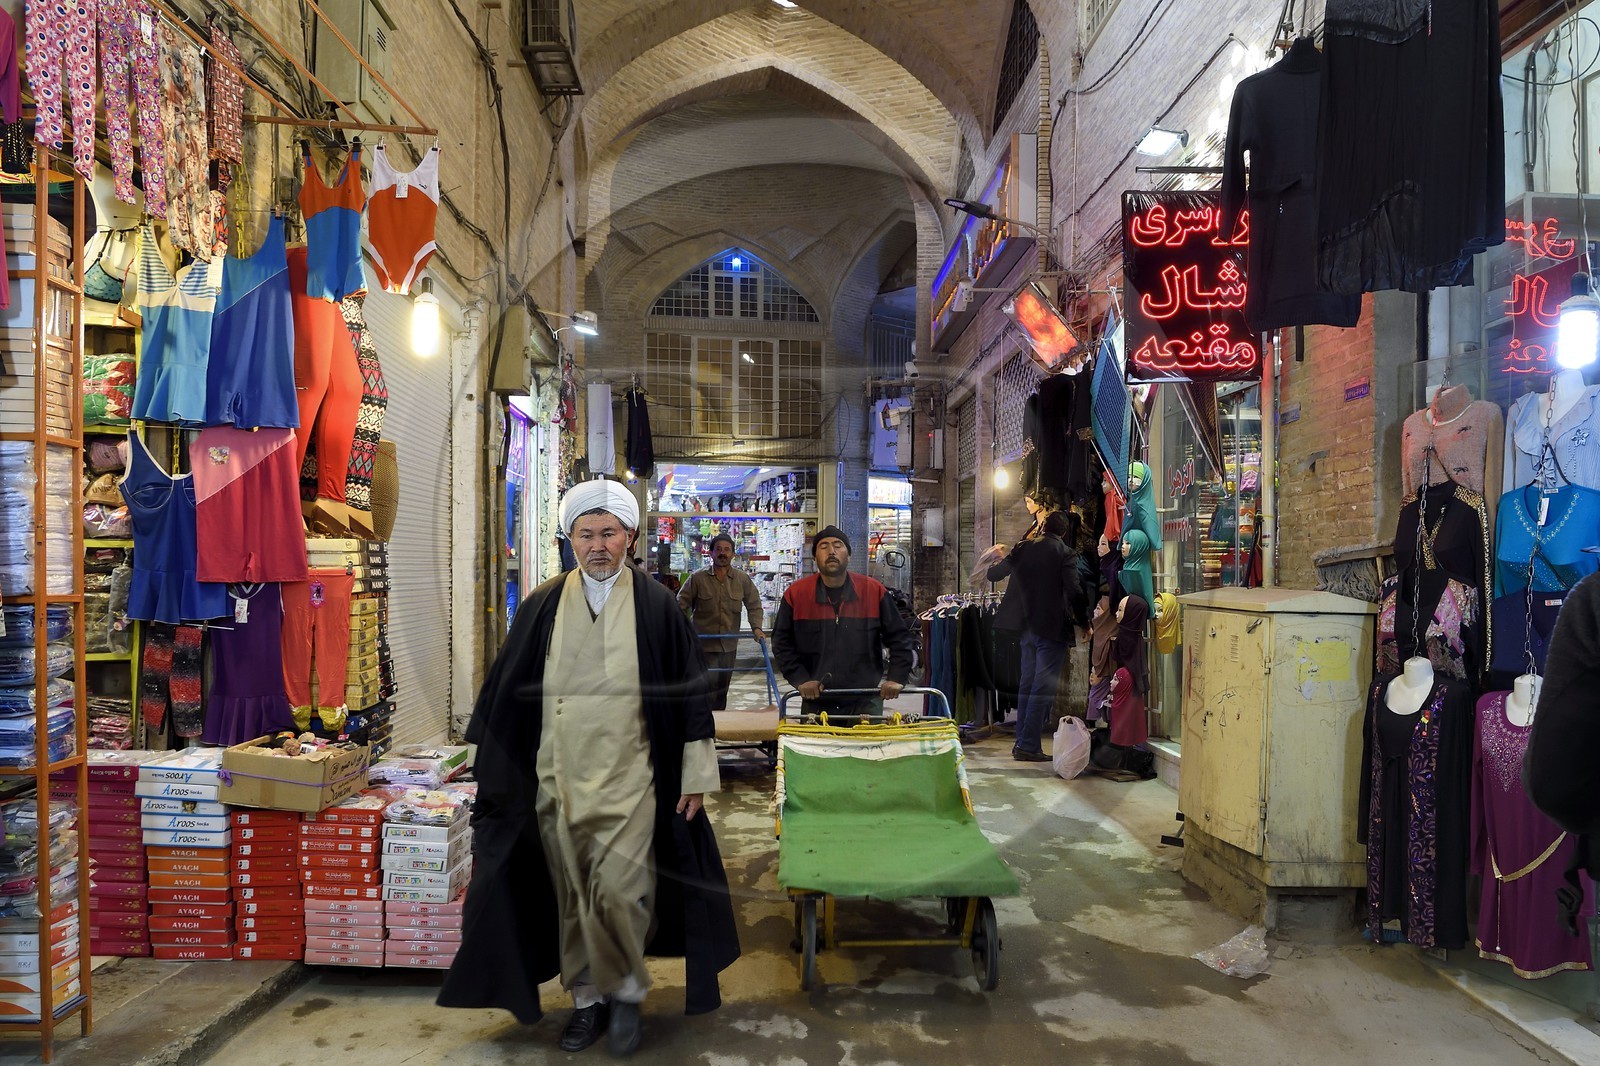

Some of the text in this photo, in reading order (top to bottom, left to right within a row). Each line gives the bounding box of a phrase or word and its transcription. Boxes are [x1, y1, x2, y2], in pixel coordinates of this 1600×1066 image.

[1141, 259, 1247, 319] شال
[1134, 323, 1257, 369] مقنعه
[369, 543, 380, 551] NANO
[370, 556, 381, 564] NANO
[370, 568, 382, 576] NANO
[372, 581, 384, 589] NANO
[165, 772, 193, 783] Aroos
[162, 784, 189, 796] Aroos
[144, 800, 166, 809] Aroos
[168, 816, 196, 828] Aroos
[169, 832, 197, 843] Aroos
[329, 902, 358, 911] Arman
[411, 905, 439, 913] Arman
[330, 916, 358, 924] Arman
[411, 918, 439, 926] Arman
[330, 929, 358, 937] Arman
[414, 931, 443, 939] Arman
[331, 942, 360, 950] Arman
[411, 944, 439, 952] Arman
[330, 955, 359, 964] Arman
[410, 957, 438, 965] Arman
